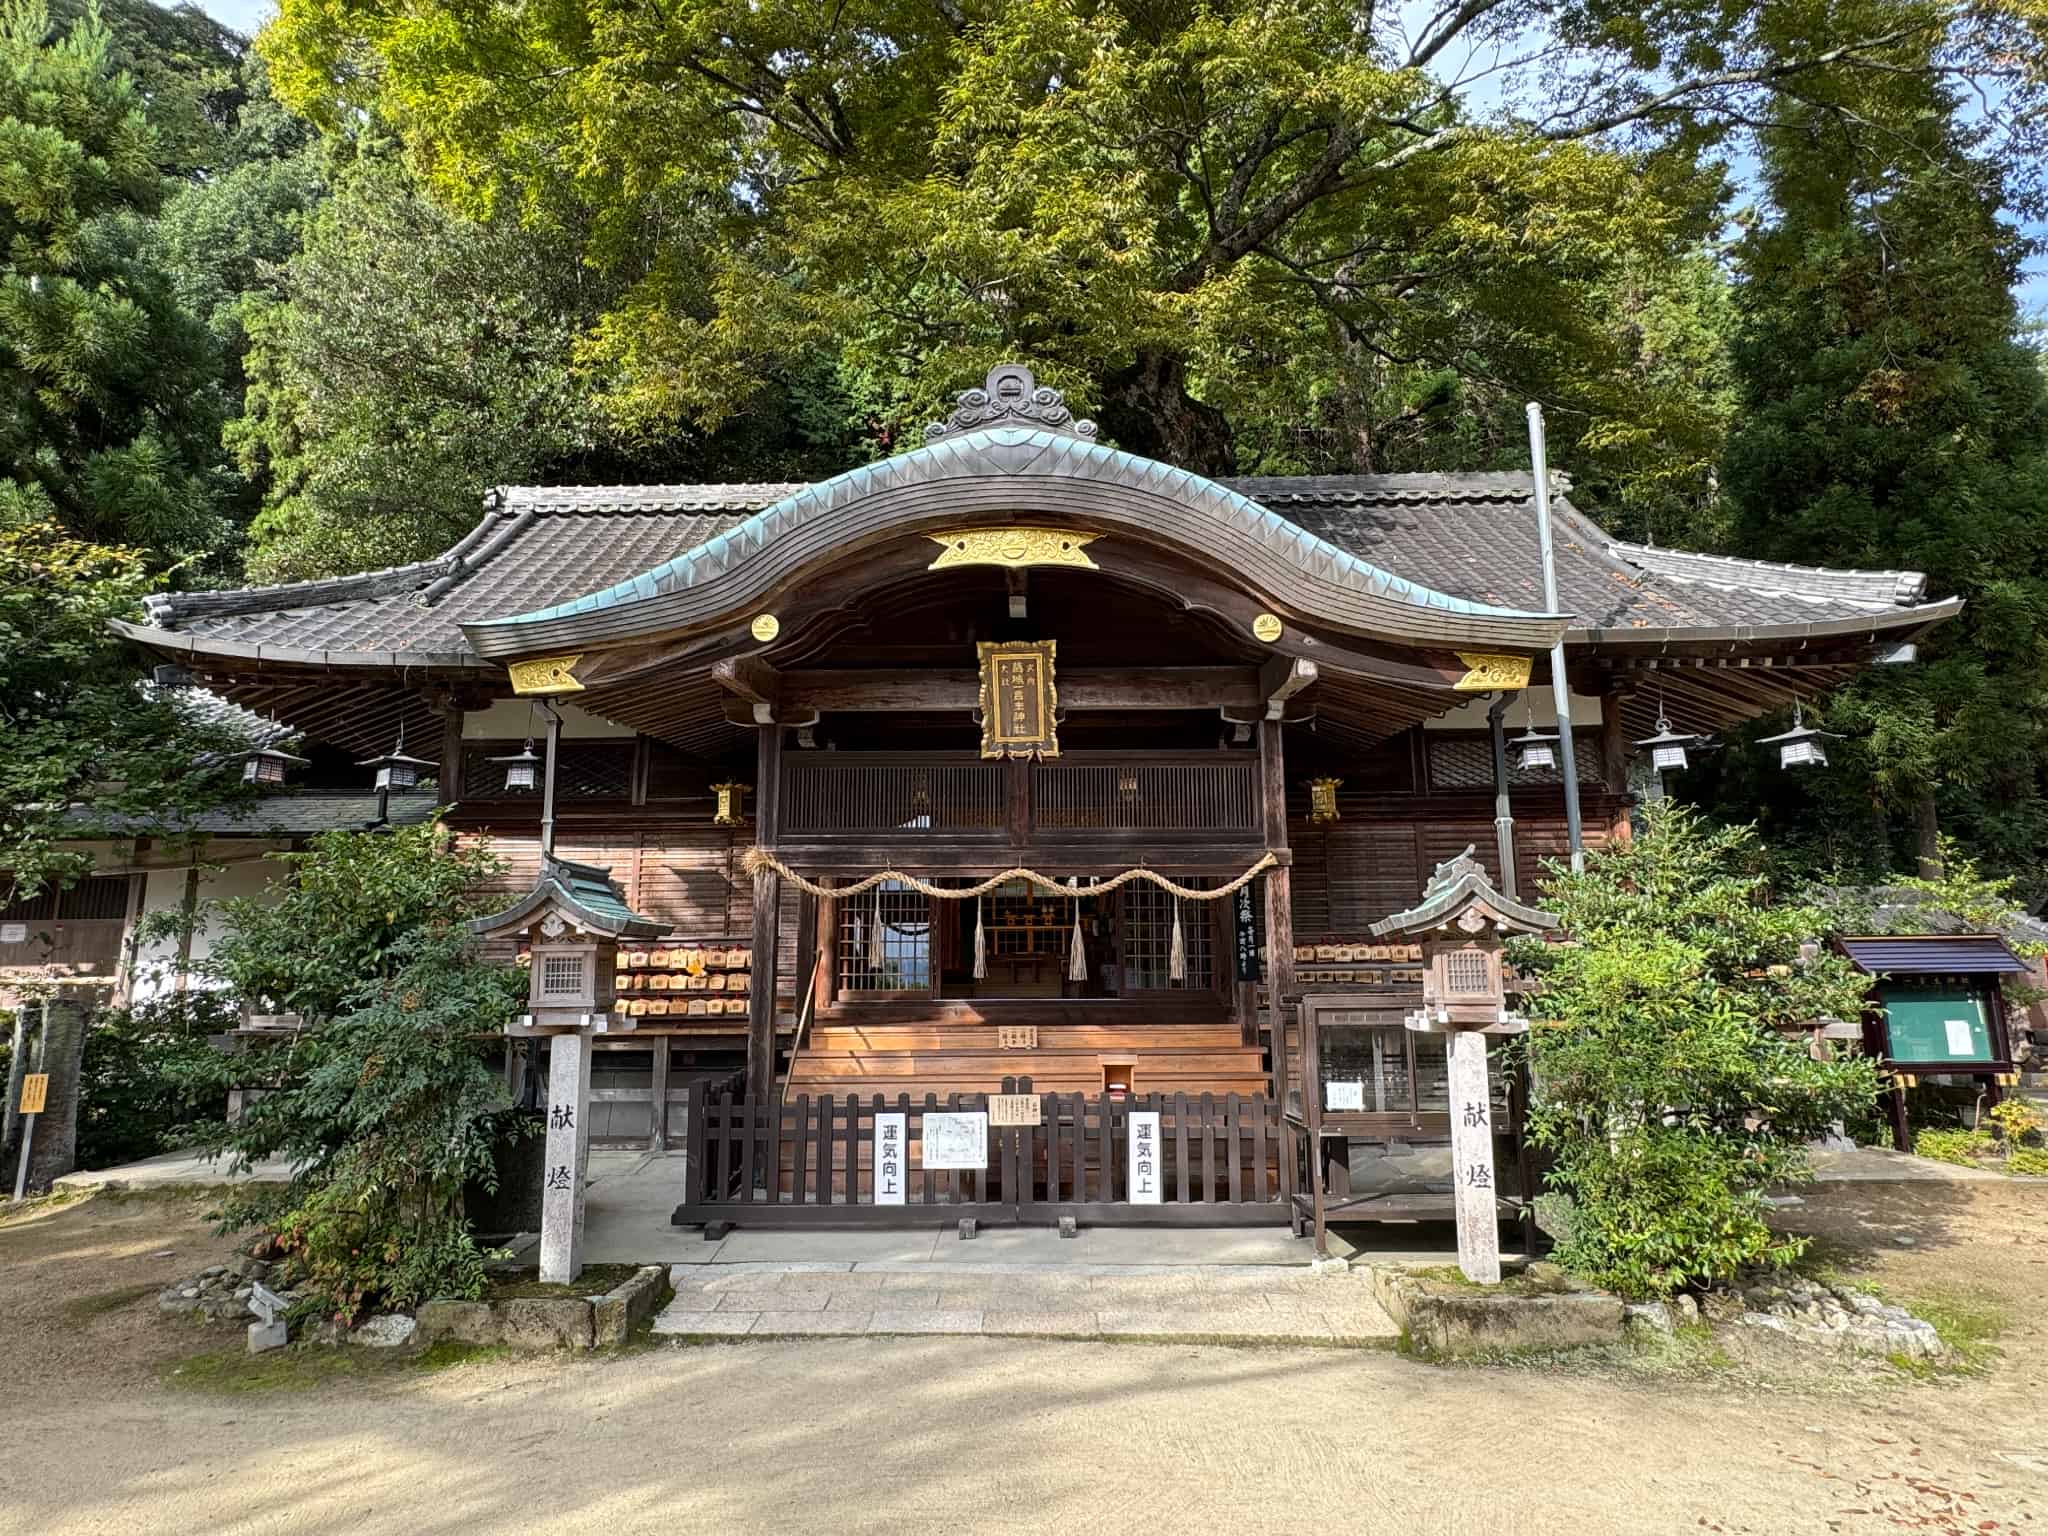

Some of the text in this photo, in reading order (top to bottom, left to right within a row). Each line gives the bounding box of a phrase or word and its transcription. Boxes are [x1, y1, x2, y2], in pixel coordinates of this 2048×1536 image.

[547, 1104, 575, 1190] 献燈
[882, 1124, 898, 1194] 運気向上
[1137, 1123, 1153, 1194] 運気向上
[1463, 1101, 1492, 1189] 献燈
